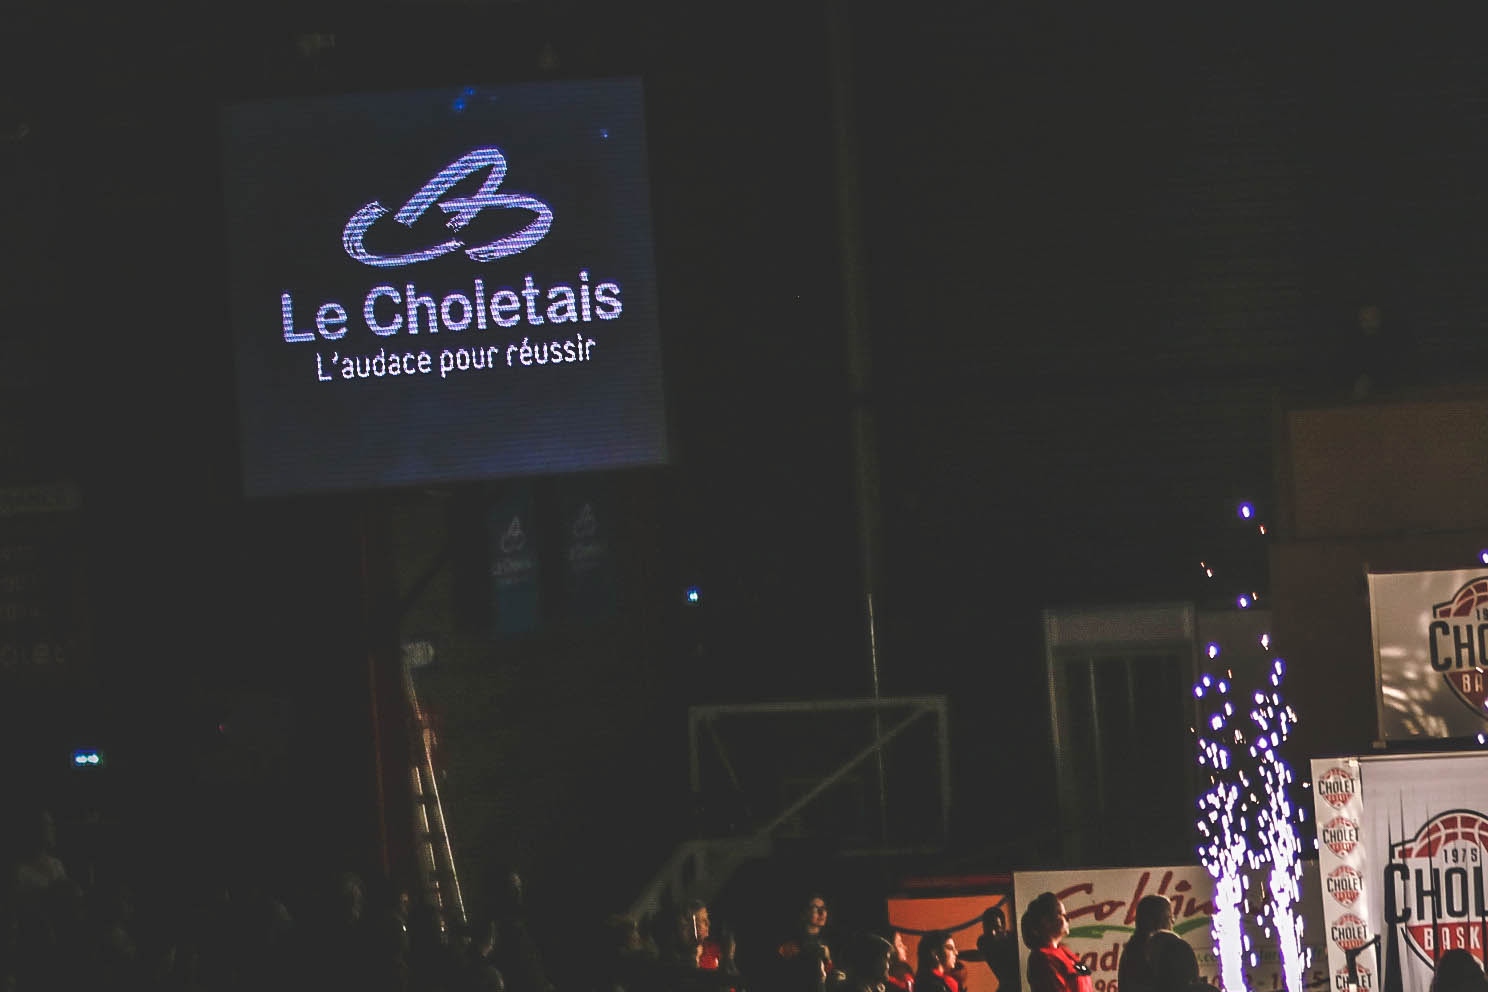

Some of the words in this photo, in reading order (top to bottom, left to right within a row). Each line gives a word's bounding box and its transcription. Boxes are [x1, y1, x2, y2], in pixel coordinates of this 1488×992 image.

[281, 292, 347, 343] Le
[362, 270, 623, 337] Choletais
[316, 348, 432, 381] L'audace
[440, 345, 498, 378] pour
[506, 333, 597, 367] réussir
[1318, 778, 1356, 797] CHOLET
[1323, 826, 1360, 845] CHOLET
[1443, 848, 1478, 866] 1975
[1327, 875, 1364, 894] CHOLET
[1331, 924, 1368, 943] CHOLET
[1335, 973, 1373, 991] CHLET
